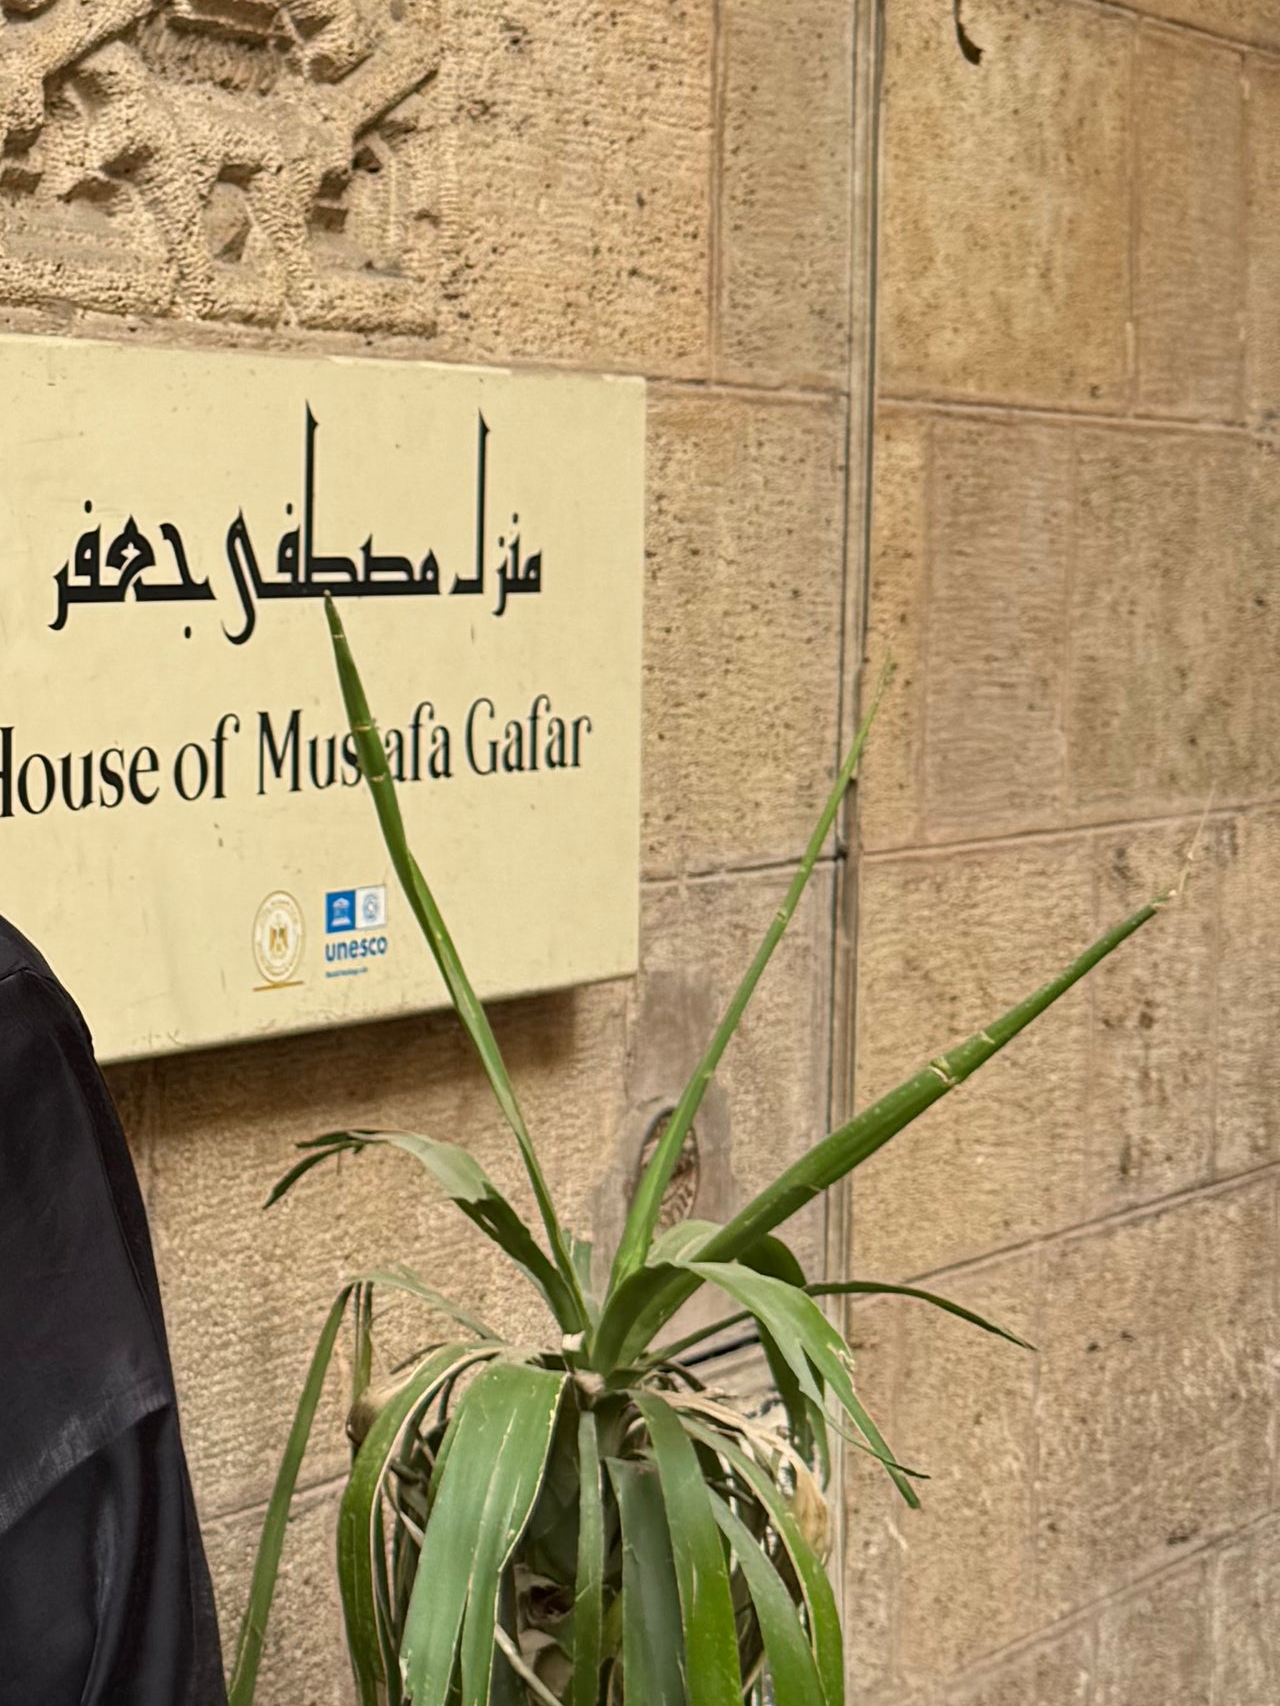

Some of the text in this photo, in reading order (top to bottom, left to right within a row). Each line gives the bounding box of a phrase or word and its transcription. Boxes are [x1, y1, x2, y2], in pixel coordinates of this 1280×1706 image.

[47, 499, 218, 640] جعفر
[448, 406, 543, 617] منزل
[172, 712, 242, 802] of
[256, 699, 454, 796] Musafa
[464, 693, 593, 776] Gafar
[325, 935, 388, 963] unesco
